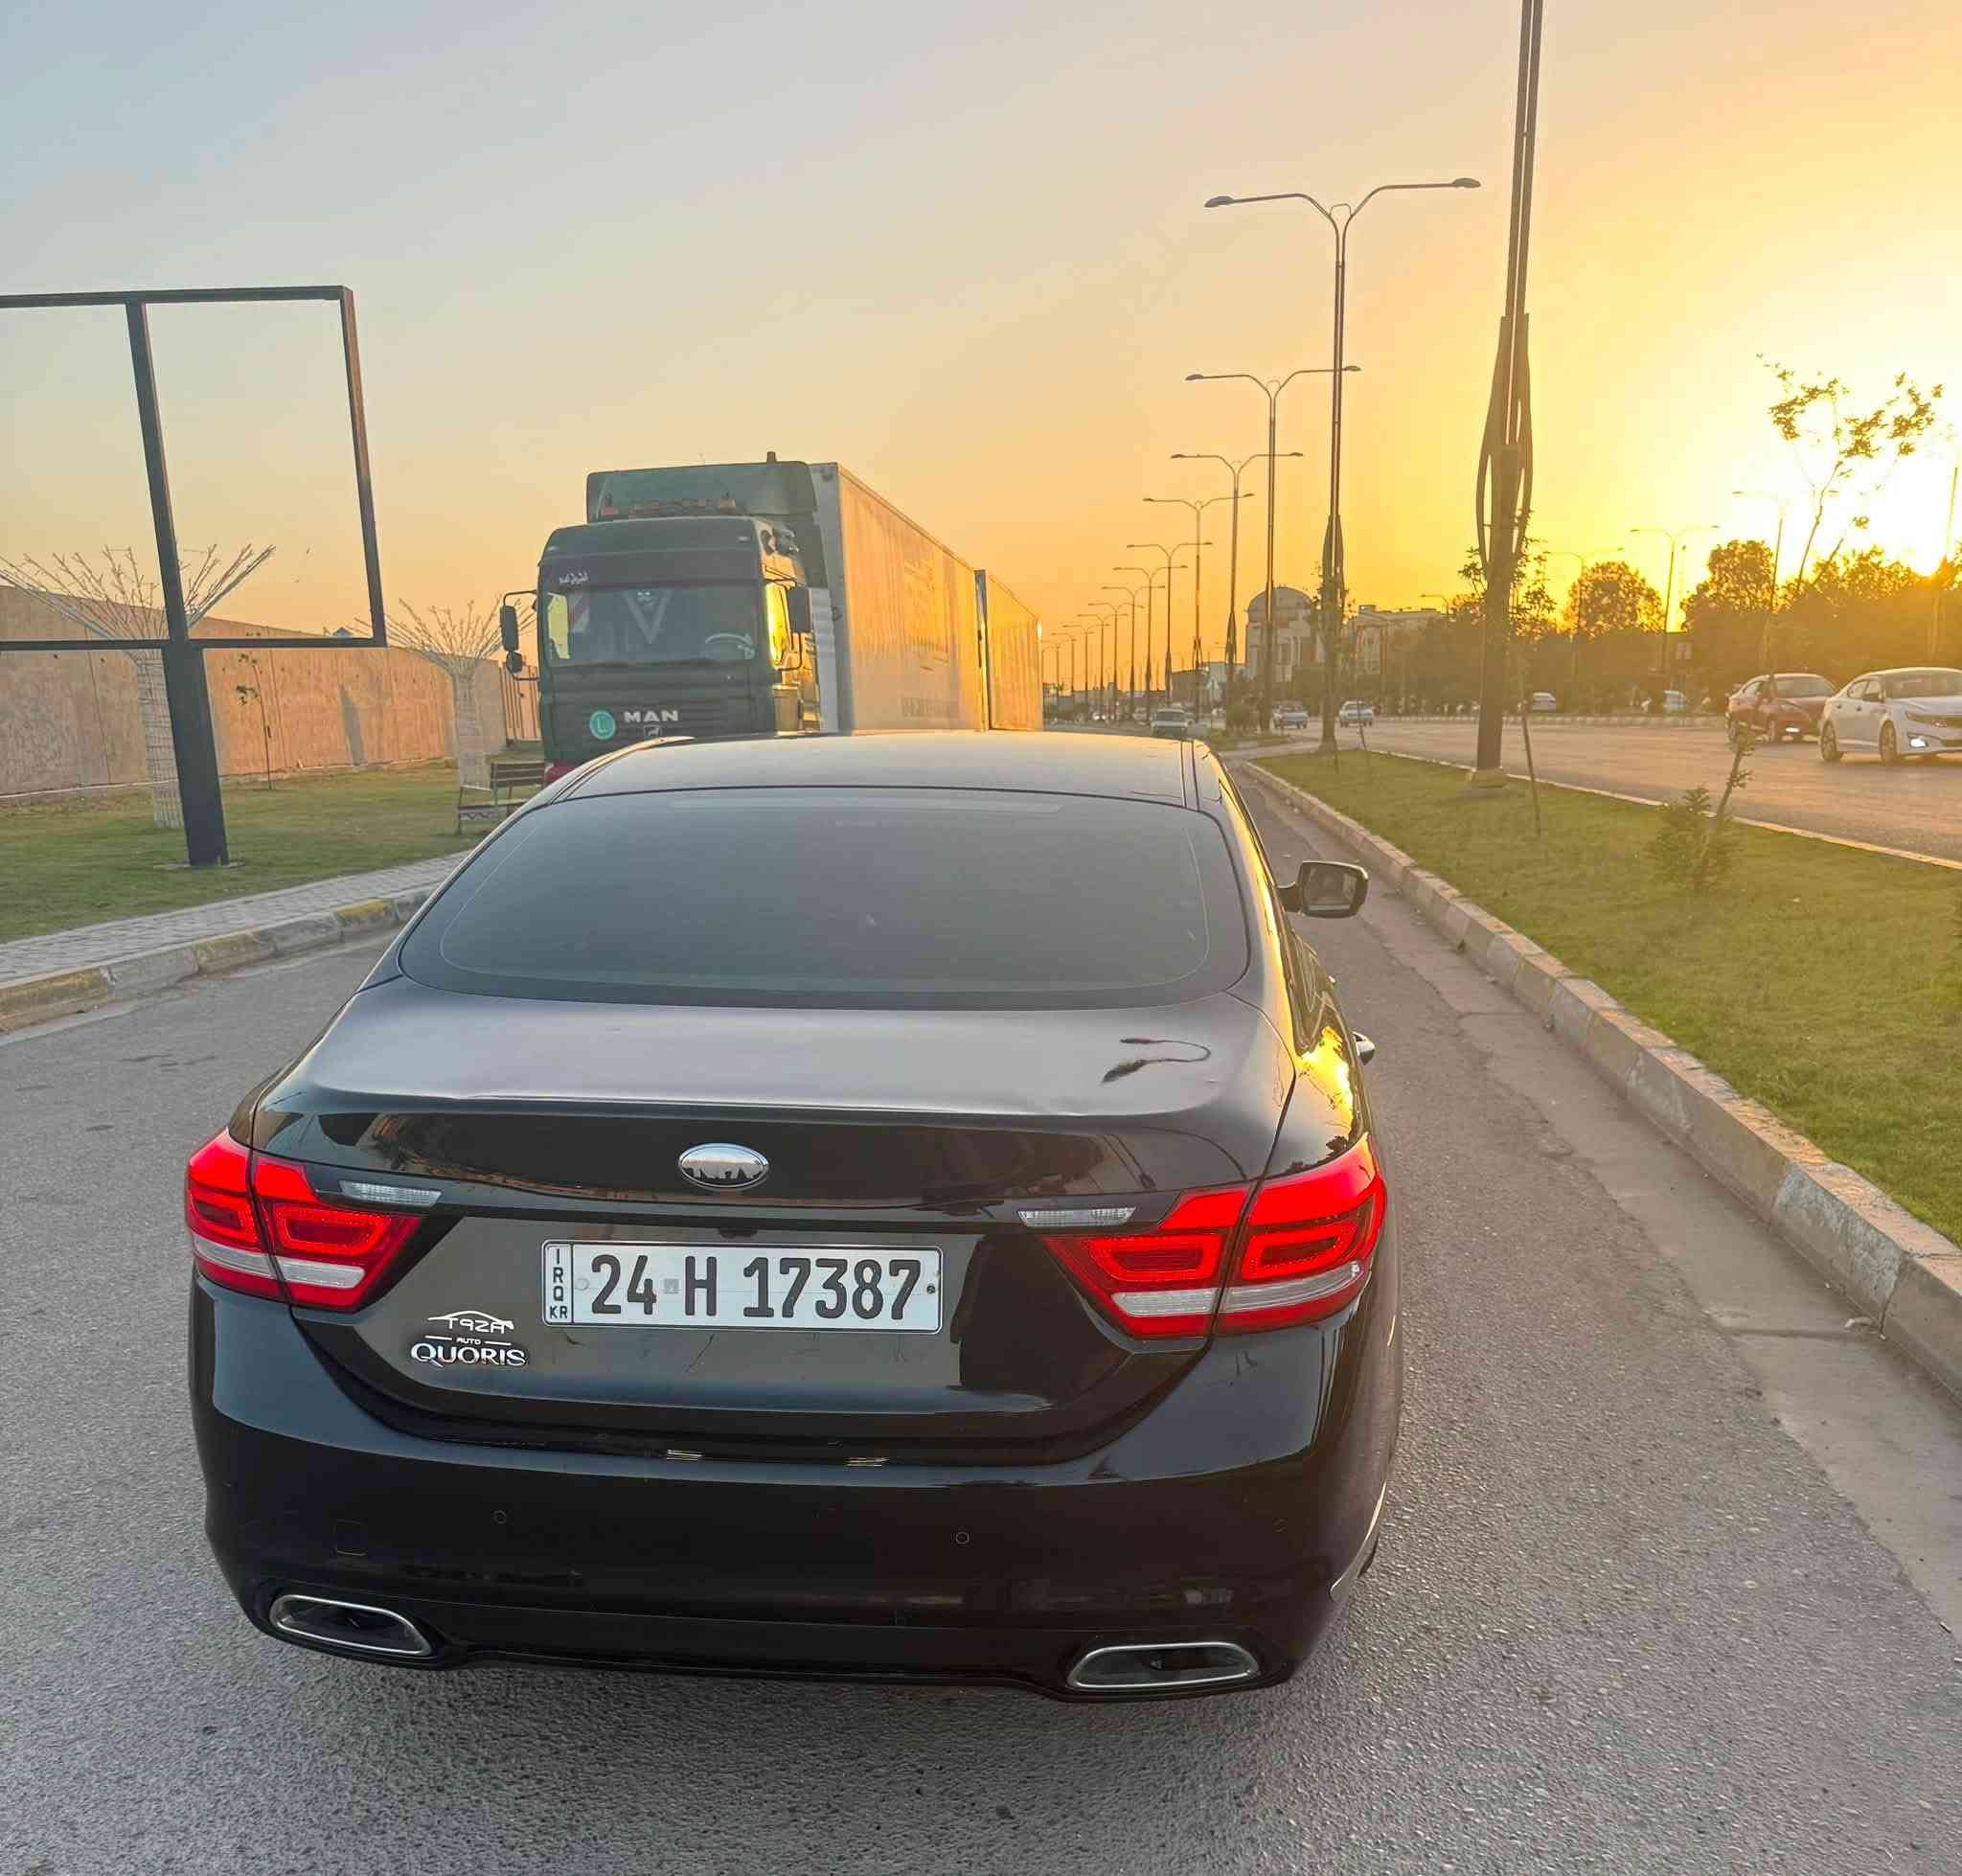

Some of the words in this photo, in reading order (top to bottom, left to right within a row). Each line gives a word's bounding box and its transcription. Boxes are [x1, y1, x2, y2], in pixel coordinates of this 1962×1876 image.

[624, 710, 679, 722] MAN
[590, 1254, 657, 1315] 24
[684, 1255, 718, 1317] H
[742, 1256, 922, 1321] 17387
[549, 1305, 569, 1320] KR
[456, 1337, 482, 1345] AUTO
[410, 1342, 527, 1368] QUORIS
